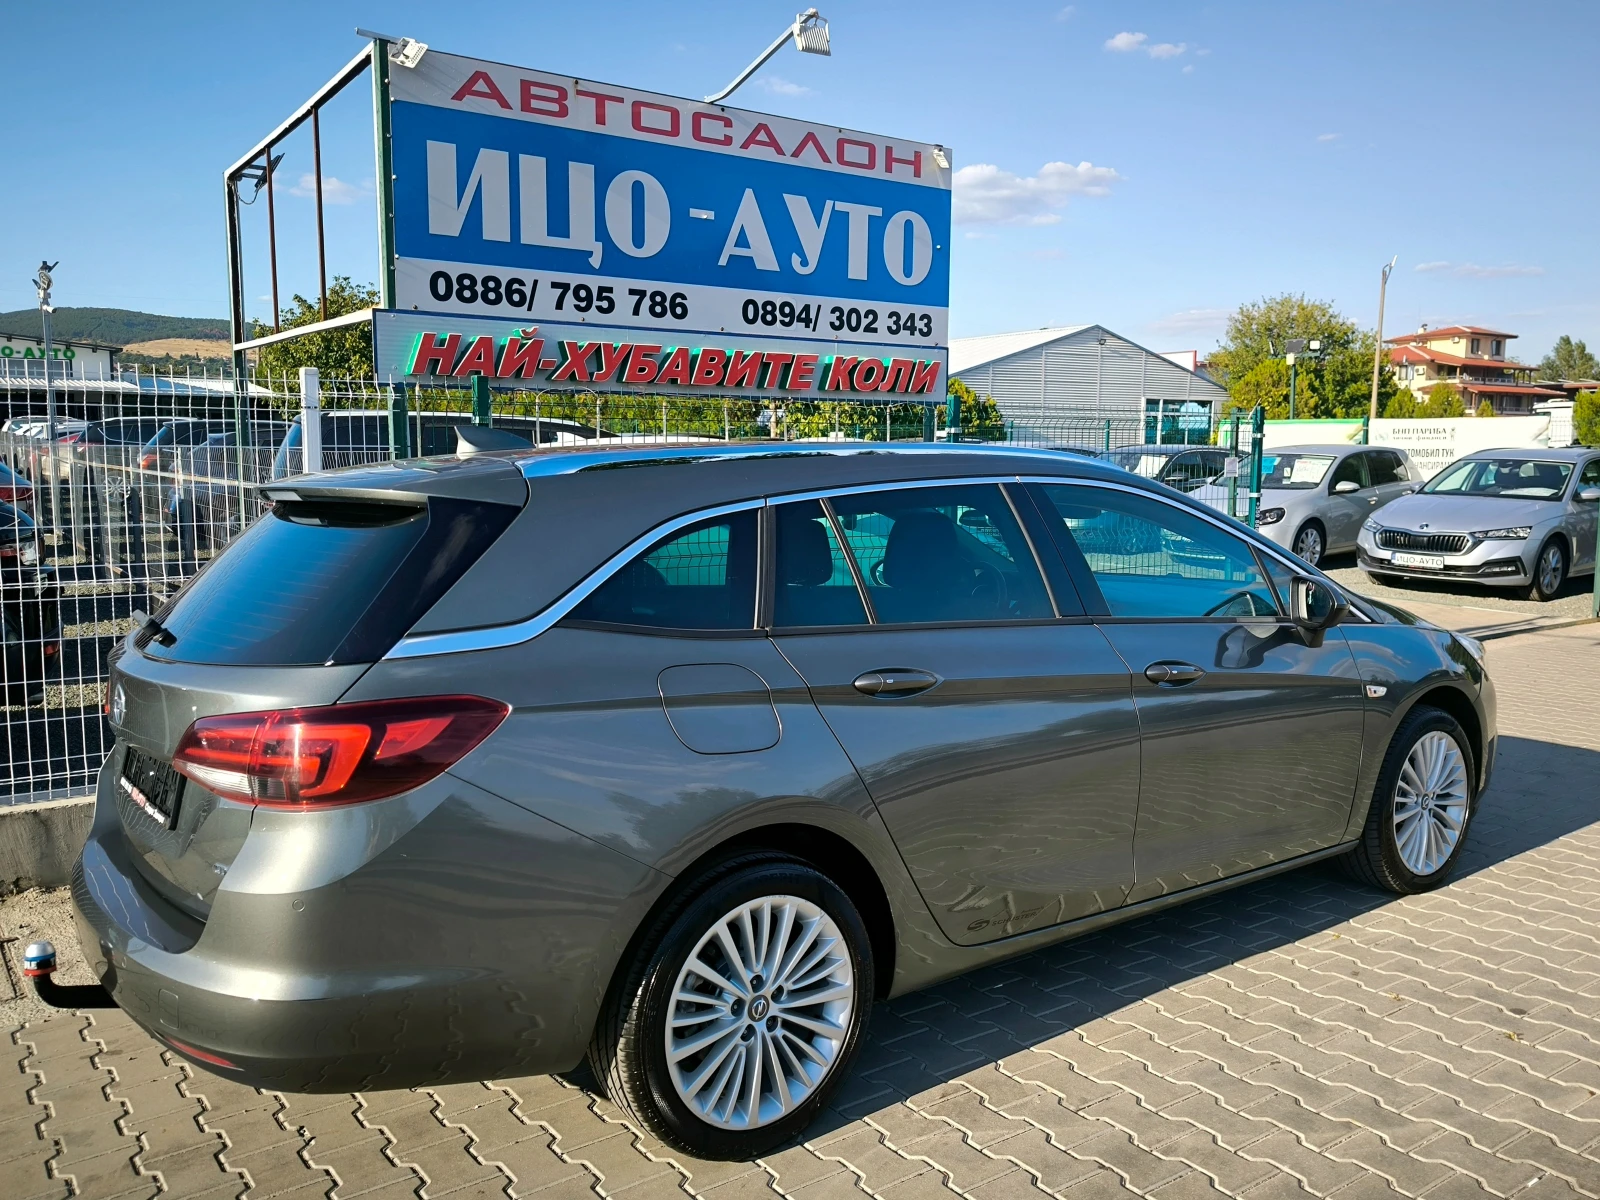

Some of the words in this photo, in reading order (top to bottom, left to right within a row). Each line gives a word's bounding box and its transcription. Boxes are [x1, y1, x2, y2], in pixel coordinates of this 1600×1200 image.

[450, 70, 922, 179] АВТОСАЛОН
[429, 271, 539, 312] 0886/
[550, 281, 616, 315] 795
[628, 288, 689, 320] 786
[742, 298, 821, 332] 0894/
[829, 305, 879, 334] 302
[886, 310, 933, 338] 343
[408, 326, 819, 391] НАЙ-ХУБАВИТЕ
[824, 354, 942, 394] КОЛИ
[1404, 448, 1440, 458] ТОМОБИЛ
[1441, 448, 1455, 458] ТУК
[1396, 555, 1443, 566] ИЦО-АУТО
